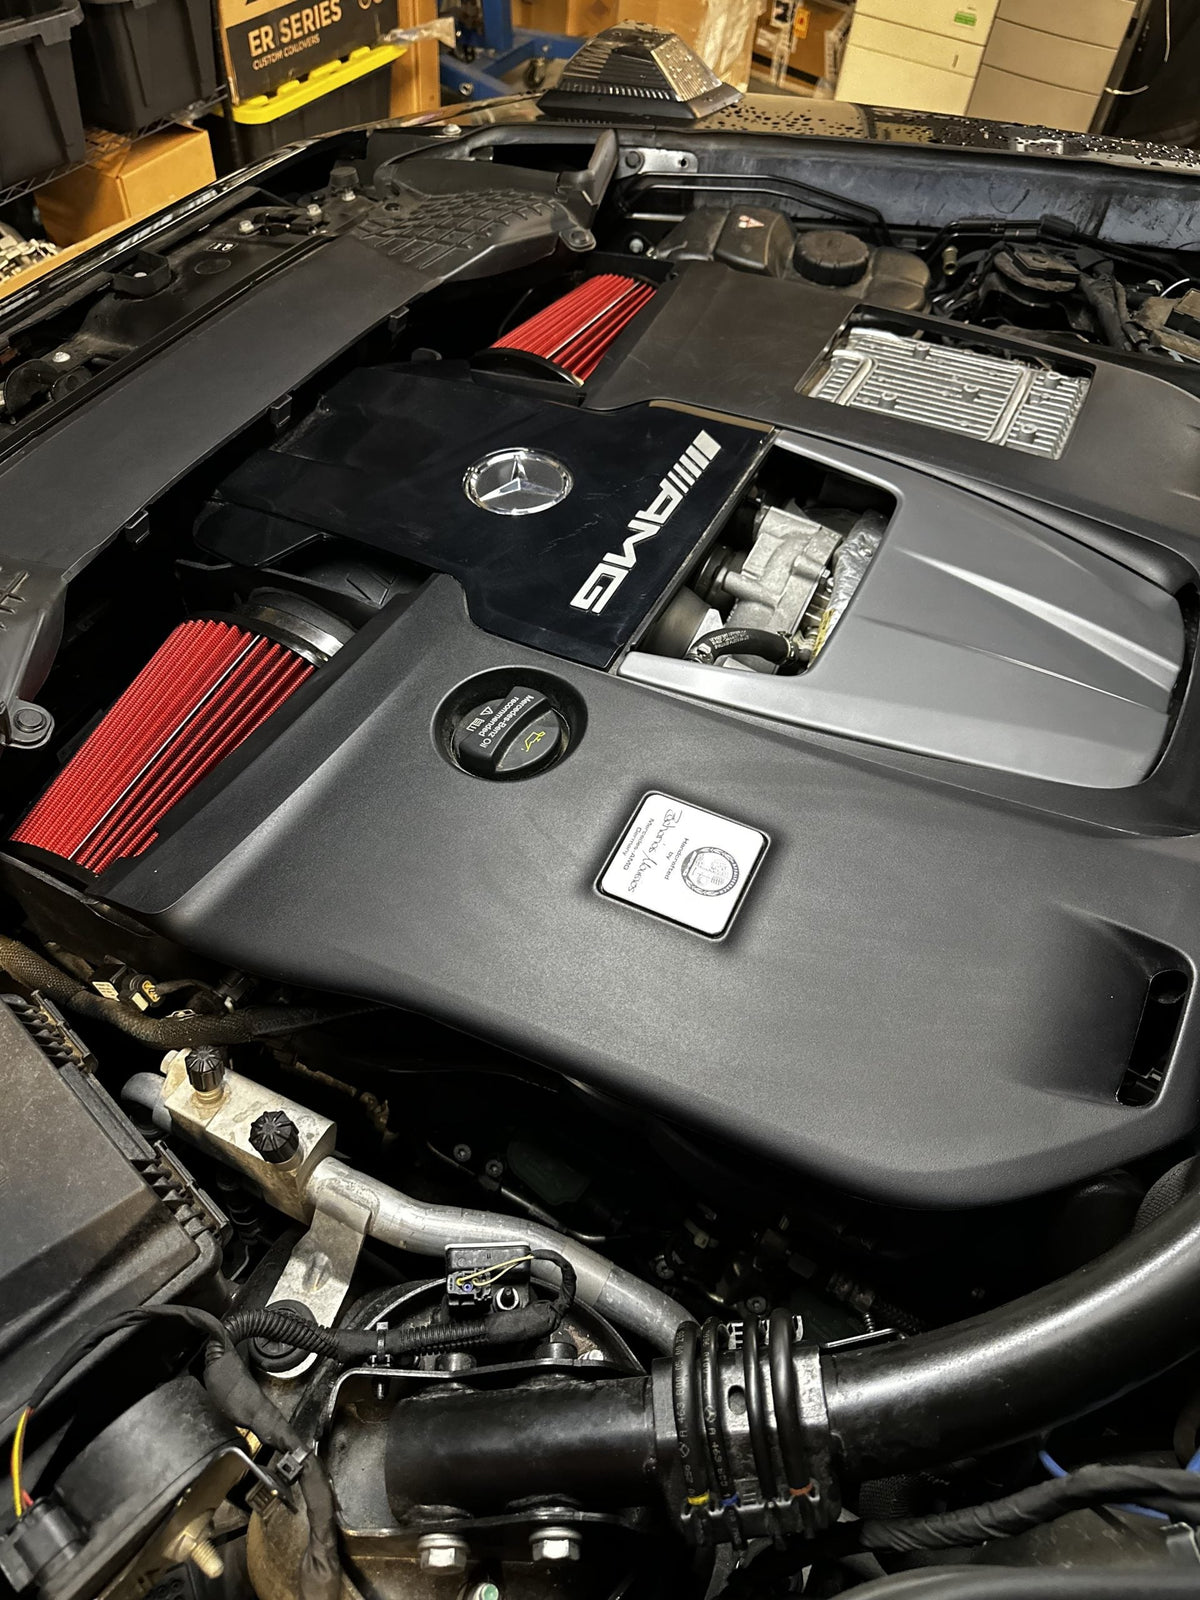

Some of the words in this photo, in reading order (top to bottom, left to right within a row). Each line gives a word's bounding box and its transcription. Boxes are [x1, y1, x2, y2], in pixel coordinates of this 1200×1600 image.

[248, 25, 276, 57] ER
[279, 0, 342, 44] SERIES
[252, 51, 283, 71] CUSTOM
[283, 34, 320, 58] COILOVERS
[570, 478, 684, 614] AMG
[478, 696, 519, 737] recommended
[489, 695, 534, 738] Mercedes-Benz
[622, 826, 642, 856] Germany
[664, 837, 689, 880] Handcrafted
